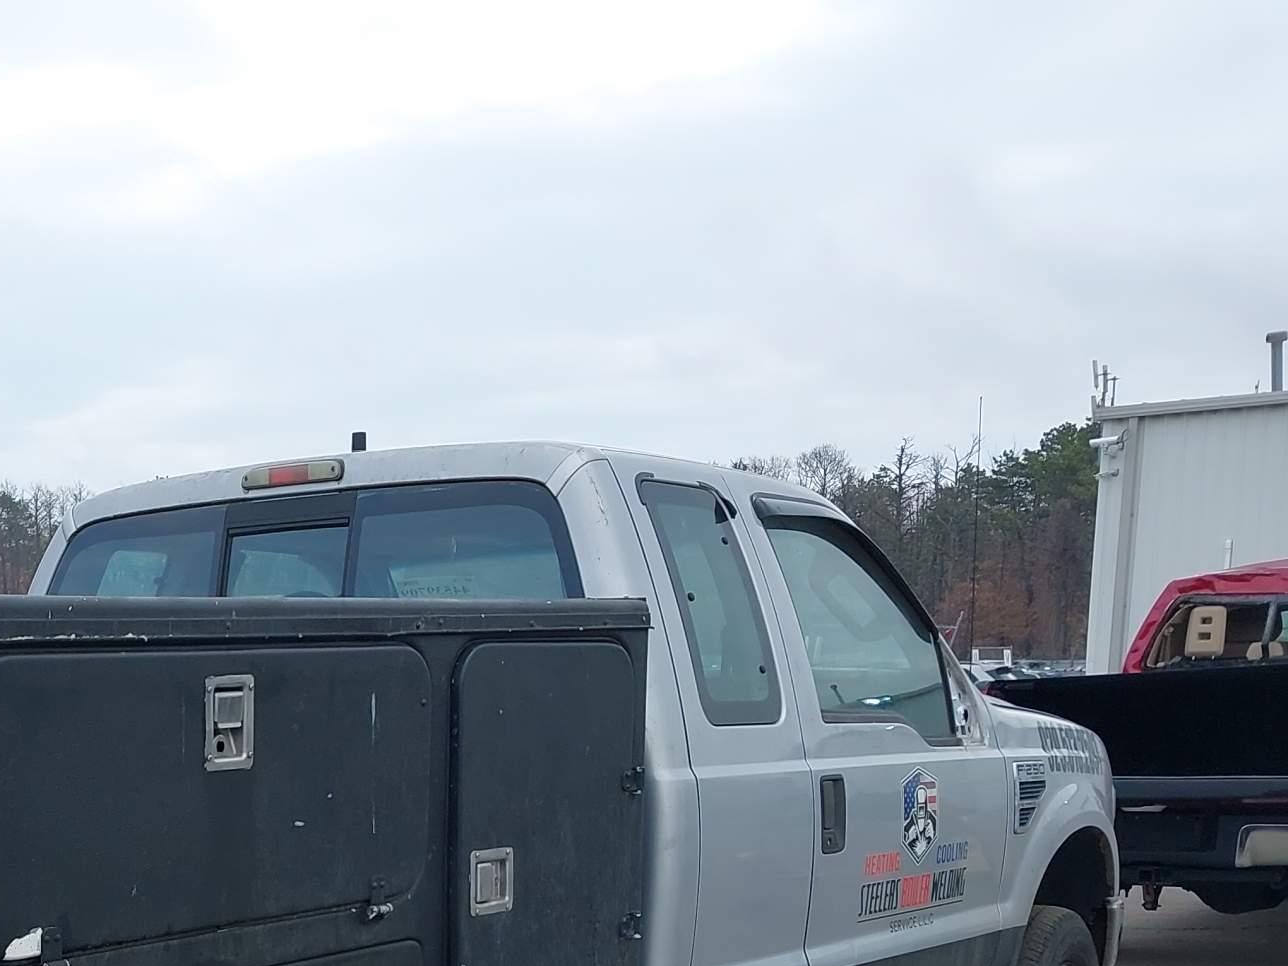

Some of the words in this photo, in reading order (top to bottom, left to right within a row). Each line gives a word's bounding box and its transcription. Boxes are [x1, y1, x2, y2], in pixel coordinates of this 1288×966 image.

[865, 853, 900, 874] HEATING
[937, 841, 968, 864] COOLING
[858, 879, 901, 916] STEELERS
[901, 874, 931, 908] BOILER
[930, 867, 967, 902] WELDING
[889, 916, 917, 933] SERVICE
